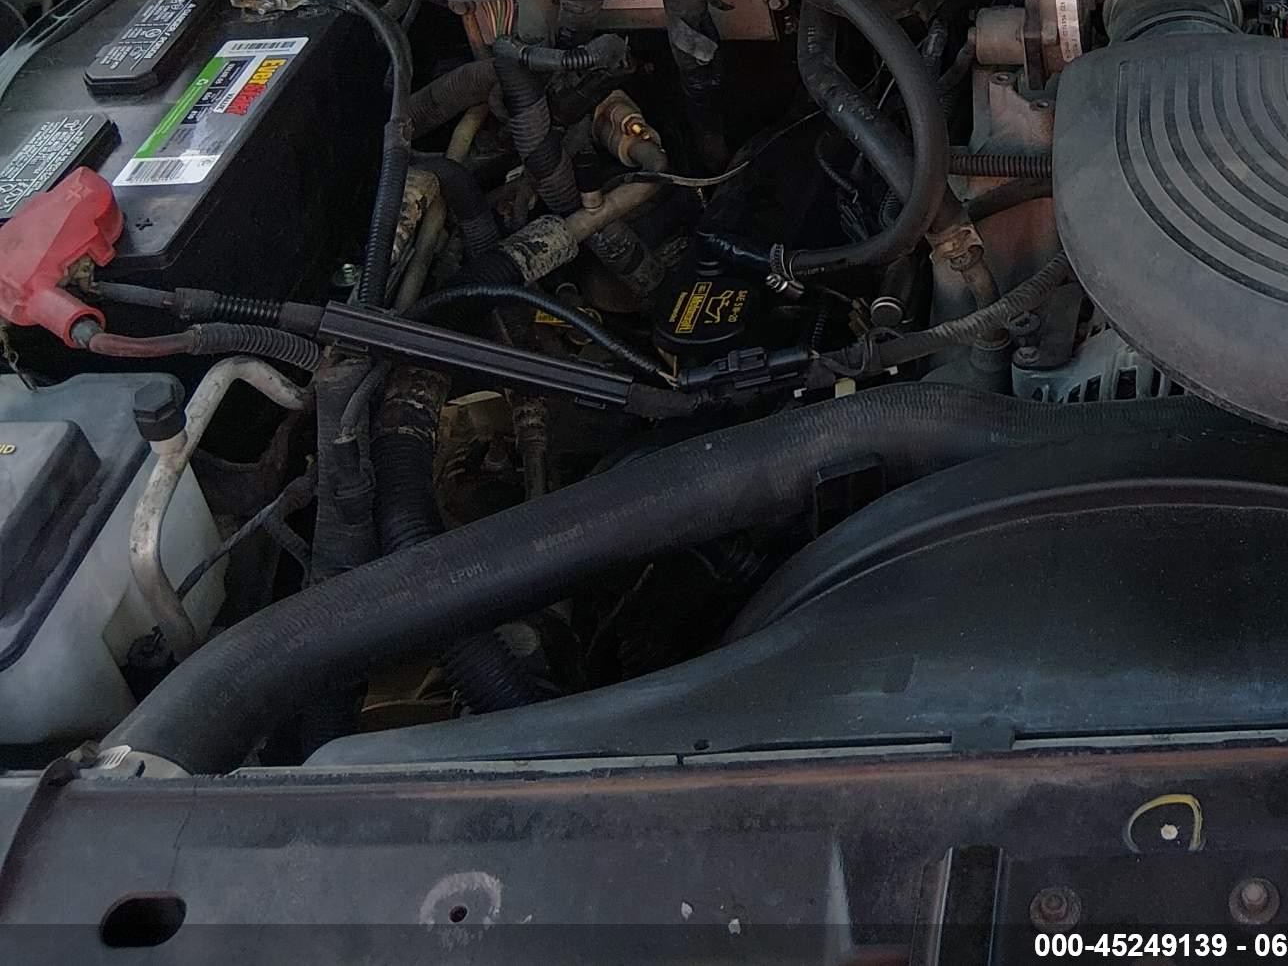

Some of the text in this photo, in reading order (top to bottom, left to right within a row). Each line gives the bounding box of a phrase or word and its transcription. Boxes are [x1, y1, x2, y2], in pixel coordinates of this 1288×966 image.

[224, 58, 288, 116] EverStart
[217, 92, 235, 111] VALUE
[0, 443, 17, 455] ID
